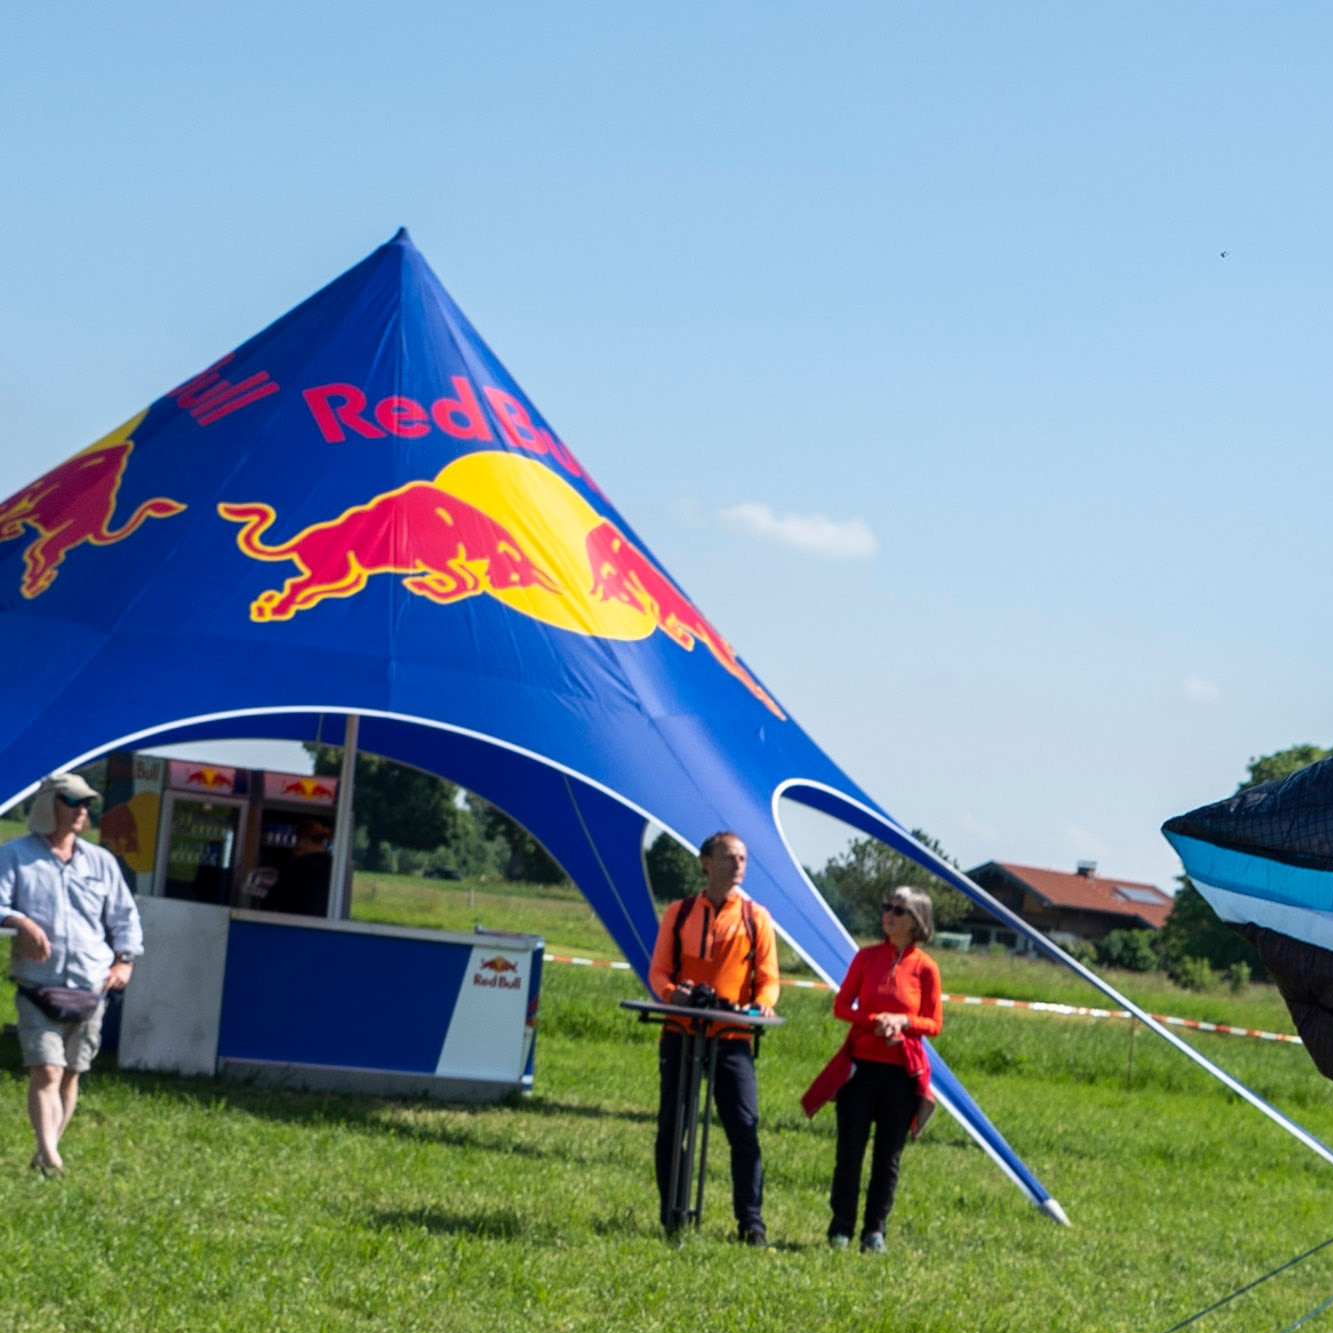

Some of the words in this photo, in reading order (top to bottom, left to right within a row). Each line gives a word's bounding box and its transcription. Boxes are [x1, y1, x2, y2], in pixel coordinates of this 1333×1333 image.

[303, 377, 494, 443] Red
[473, 973, 496, 986] Red
[498, 976, 521, 989] Bull
